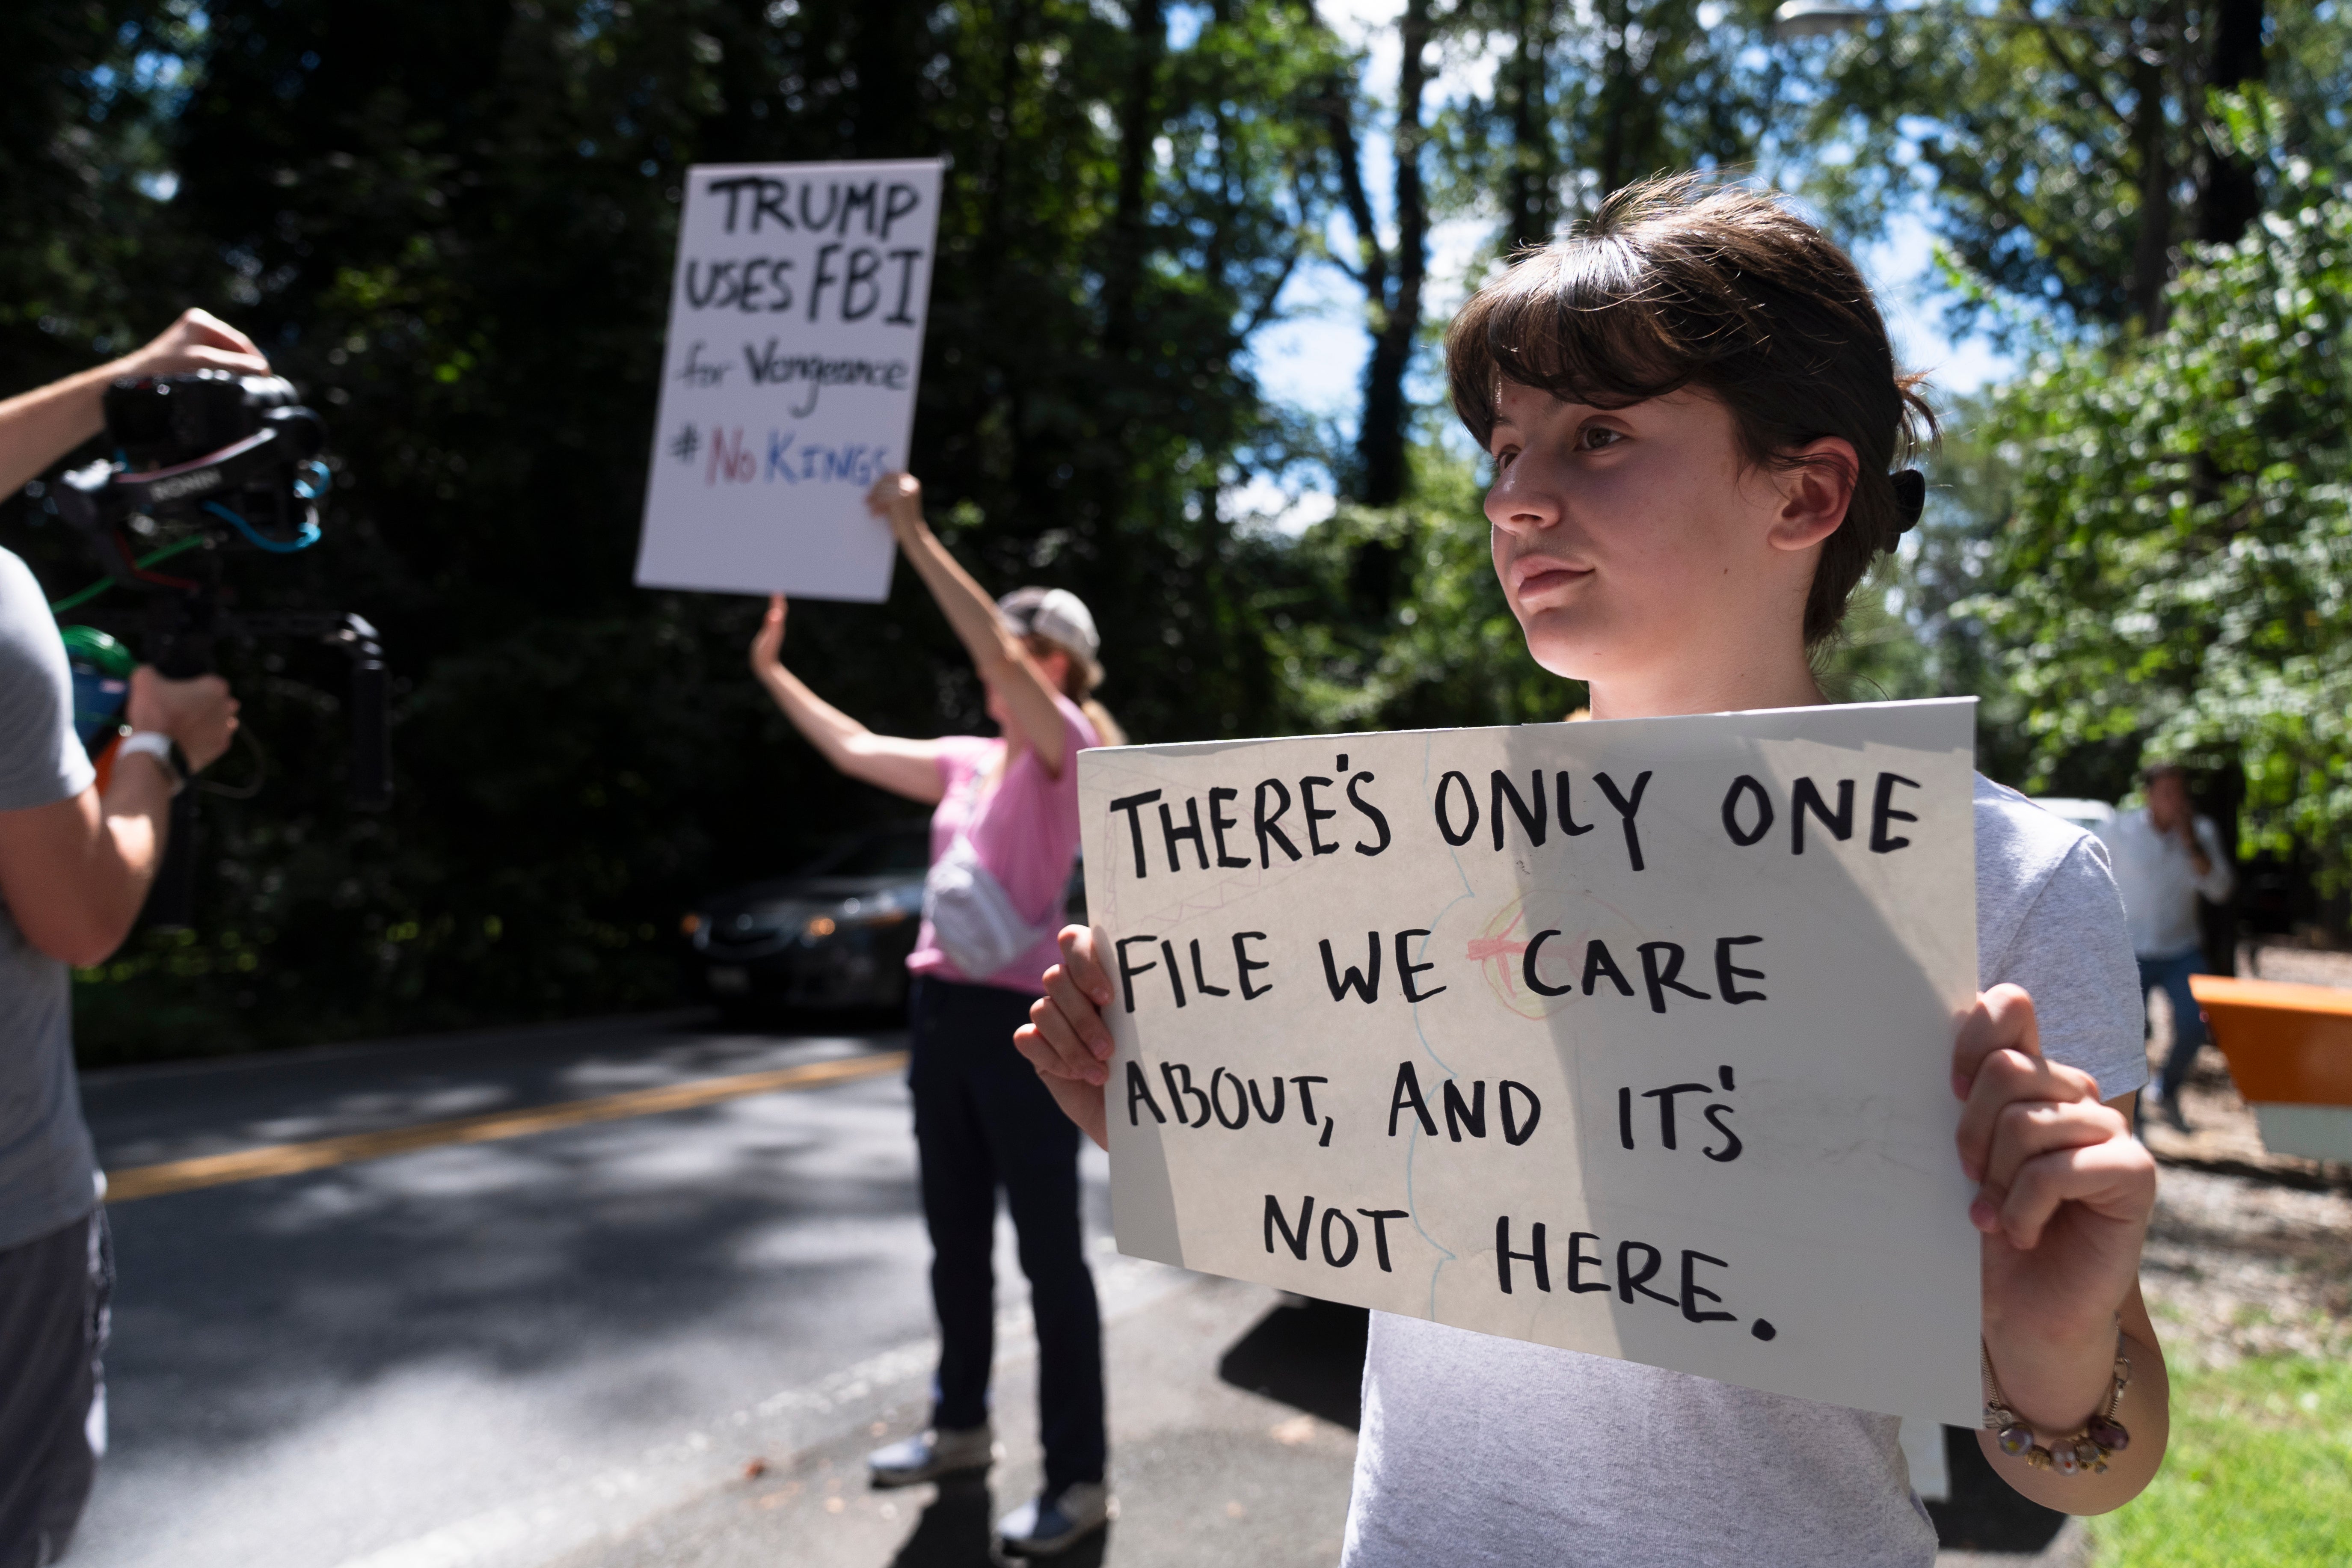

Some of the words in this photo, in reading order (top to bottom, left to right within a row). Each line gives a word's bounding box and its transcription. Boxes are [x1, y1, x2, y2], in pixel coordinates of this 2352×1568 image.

[708, 176, 921, 240] TRUMP
[685, 259, 794, 313] USES
[808, 243, 922, 326] FBI
[676, 339, 731, 387] for
[743, 338, 910, 418] Vengeance
[1110, 754, 1391, 878] THERE'S
[1435, 769, 1652, 871] ONLY
[1722, 772, 1920, 855] ONE
[1115, 931, 1272, 1013] FILE
[1318, 929, 1447, 1004] WE
[1523, 929, 1767, 1014] CARE
[1126, 1061, 1334, 1147] ABOUT,
[1388, 1061, 1541, 1146] AND
[1618, 1065, 1742, 1162] IT'S
[1264, 1195, 1409, 1272] NOT
[1496, 1216, 1776, 1341] HERE.
